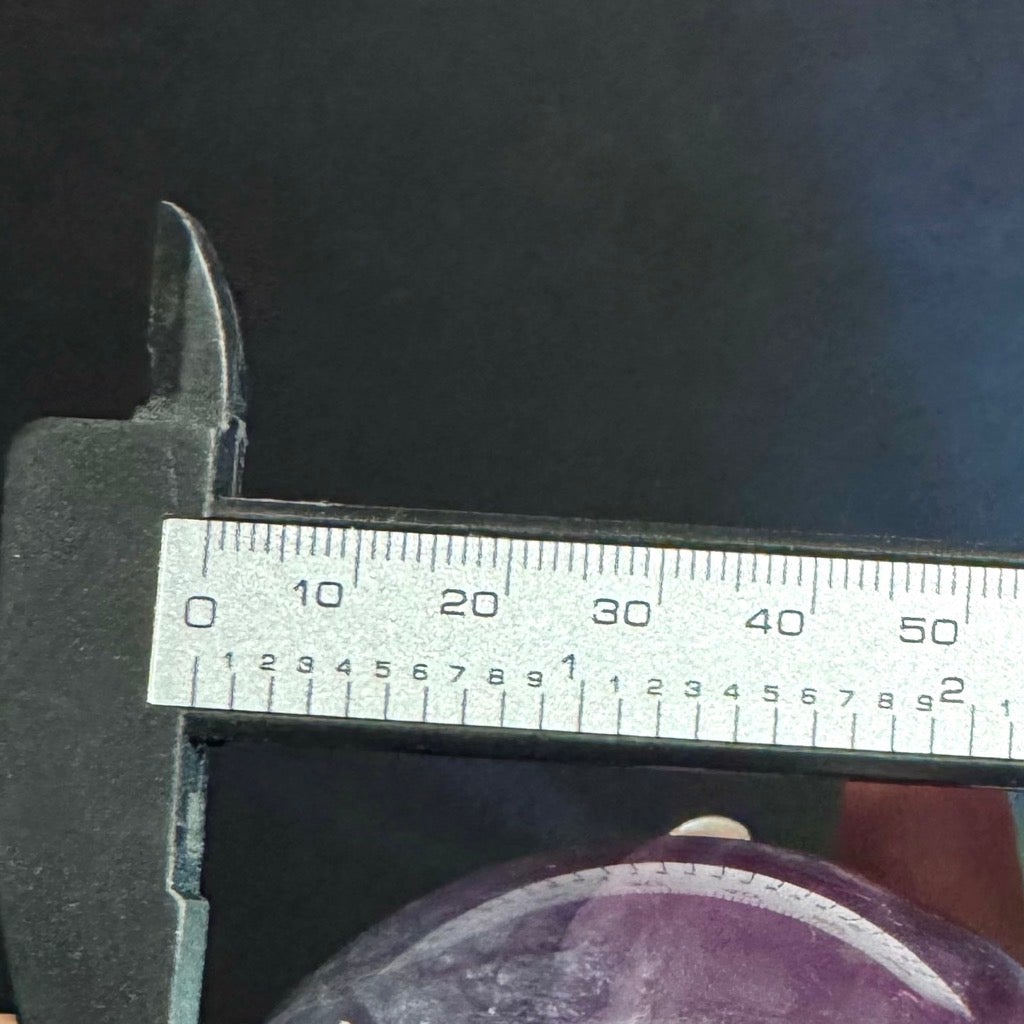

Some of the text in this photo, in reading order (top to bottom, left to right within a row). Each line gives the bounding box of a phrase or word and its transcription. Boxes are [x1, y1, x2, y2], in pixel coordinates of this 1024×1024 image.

[185, 596, 217, 628] 0
[293, 580, 343, 608] 10
[440, 588, 498, 618] 20
[592, 598, 651, 627] 30
[745, 608, 804, 636] 40
[899, 616, 958, 646] 50
[225, 652, 234, 668] 1
[259, 653, 276, 671] 2
[298, 656, 313, 673] 3
[337, 658, 351, 675] 4
[375, 661, 391, 678] 5
[412, 663, 428, 680] 6
[451, 665, 466, 682] 7
[488, 668, 504, 685] 8
[527, 671, 543, 688] 9
[562, 654, 575, 680] 1
[610, 675, 619, 692] 1
[647, 678, 662, 695] 2
[685, 681, 701, 698] 3
[724, 683, 740, 700] 4
[763, 685, 779, 702] 5
[801, 688, 817, 704] 6
[840, 689, 854, 707] 7
[878, 692, 894, 710] 8
[916, 694, 933, 712] 9
[940, 676, 965, 703] 2
[1001, 699, 1010, 716] 1
